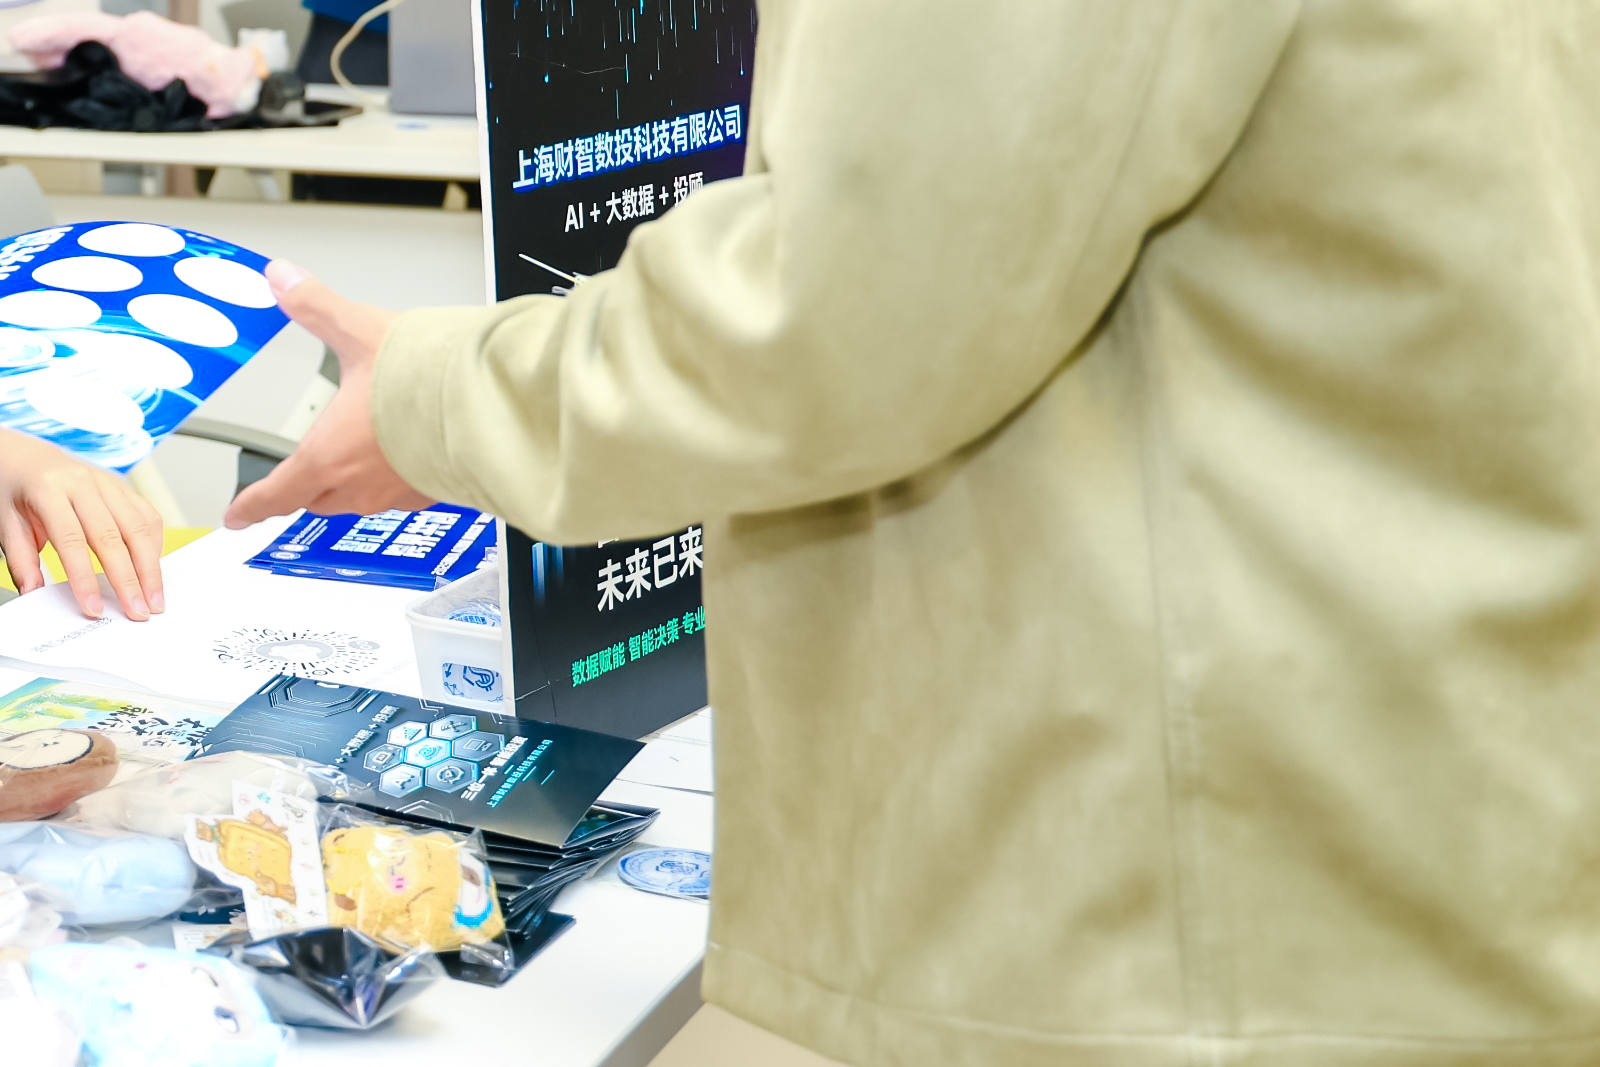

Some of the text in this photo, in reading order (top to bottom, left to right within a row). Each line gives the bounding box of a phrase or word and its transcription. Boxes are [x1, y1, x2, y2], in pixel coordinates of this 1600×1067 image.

[512, 104, 741, 189] 上海财智数投科技有限公司
[565, 202, 584, 232] AI
[590, 203, 600, 222] +
[606, 184, 655, 224] 大数据
[659, 186, 669, 205] +
[597, 526, 703, 612] 未来已来
[571, 642, 626, 687] 数据赋能
[628, 617, 680, 662] 智能决策
[341, 729, 375, 756] 大数据
[460, 767, 498, 801] 三位一体
